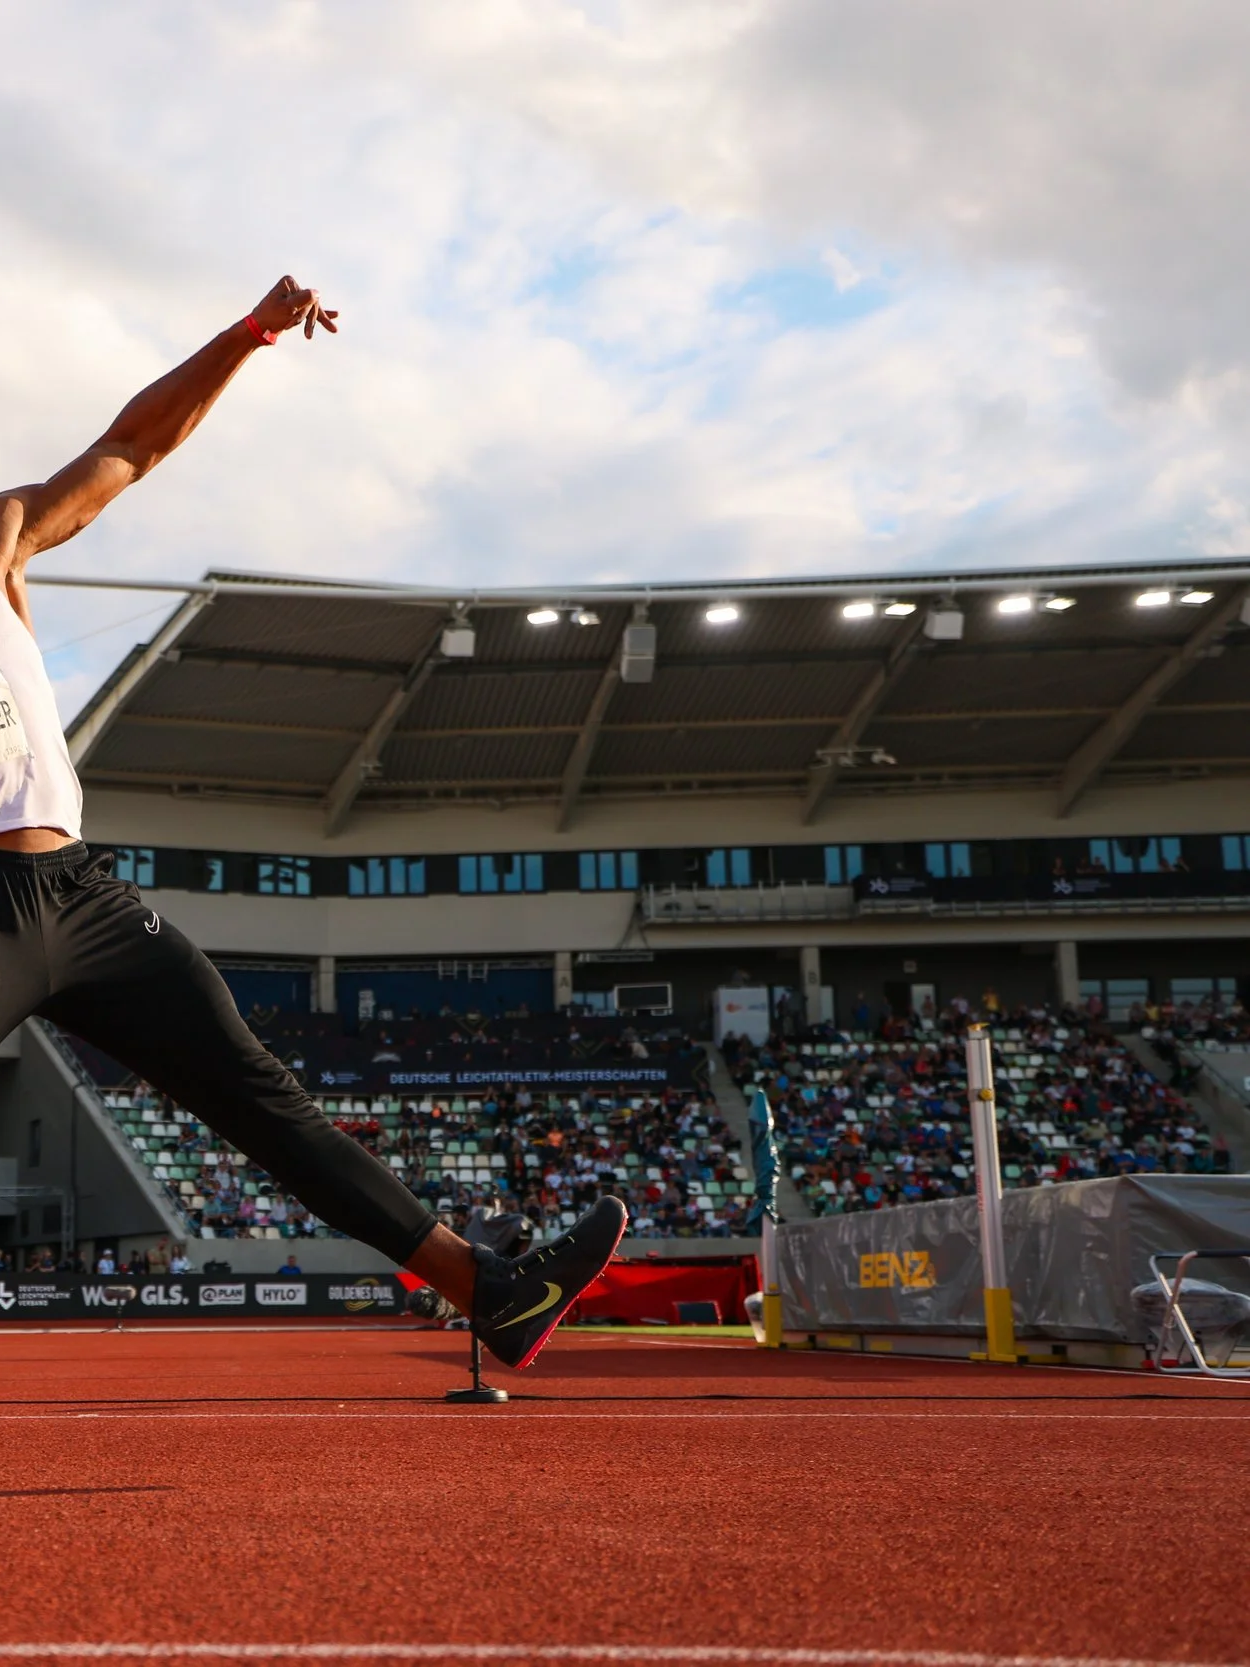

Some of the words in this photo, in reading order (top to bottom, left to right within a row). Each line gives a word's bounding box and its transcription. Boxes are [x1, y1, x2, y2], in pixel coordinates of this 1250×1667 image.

[389, 1072, 451, 1085] DEUTSCHE
[859, 1250, 932, 1289] BENZ
[218, 1289, 243, 1298] PLAN
